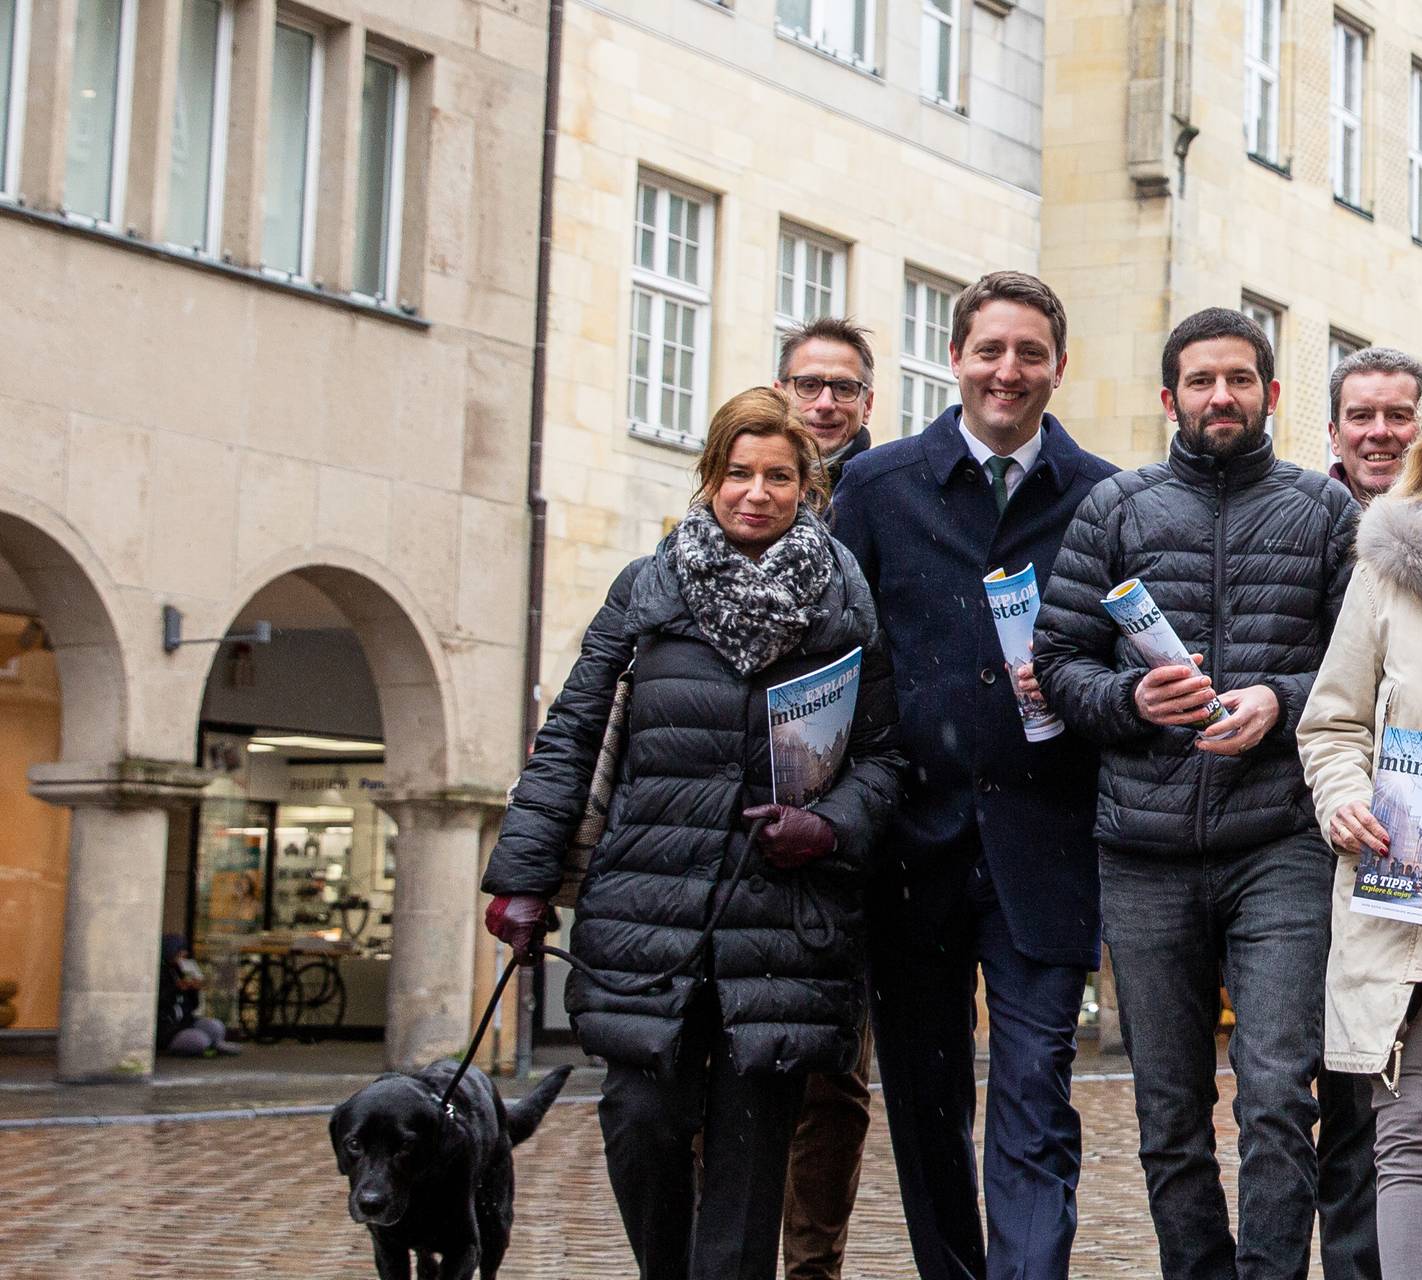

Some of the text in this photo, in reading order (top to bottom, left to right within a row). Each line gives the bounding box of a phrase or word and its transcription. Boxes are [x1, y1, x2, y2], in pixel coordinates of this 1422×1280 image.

[806, 664, 860, 703] EXPLORE
[771, 686, 844, 727] münster
[1361, 884, 1386, 895] explore
[1393, 890, 1412, 900] enjoy
[1363, 873, 1414, 892] 66 TIPPS
